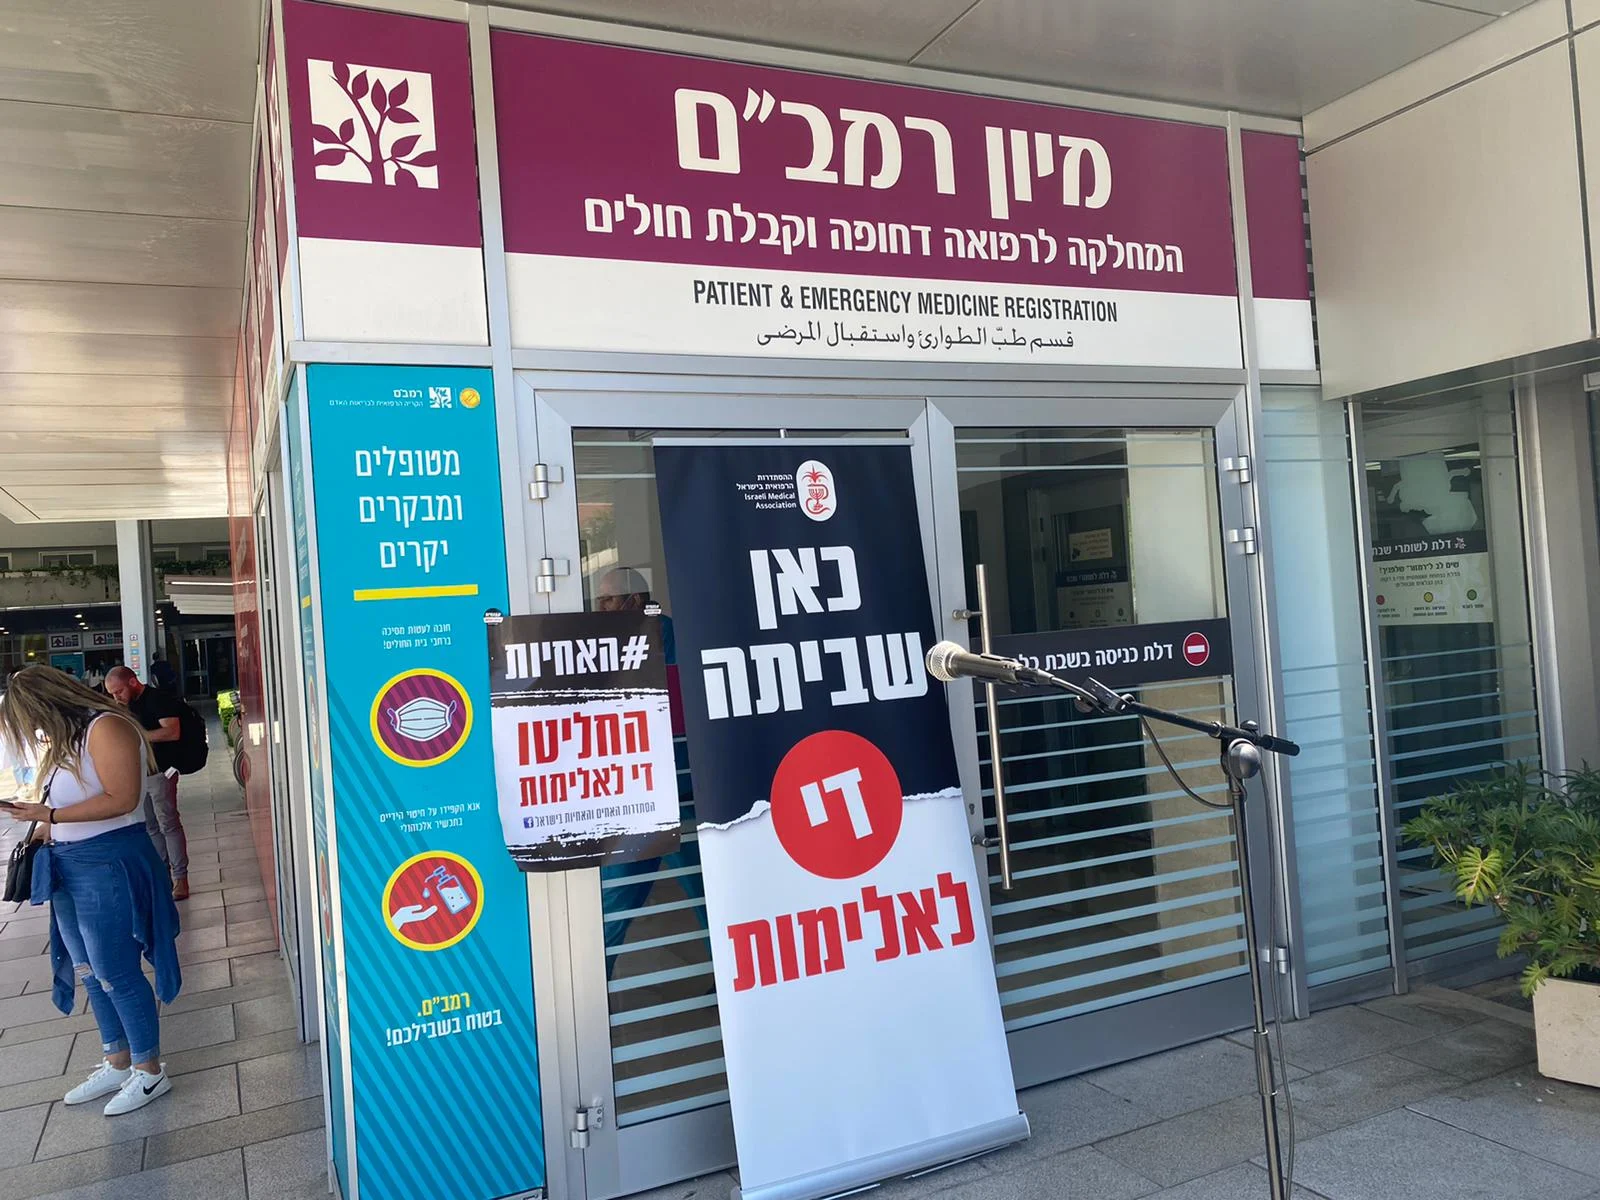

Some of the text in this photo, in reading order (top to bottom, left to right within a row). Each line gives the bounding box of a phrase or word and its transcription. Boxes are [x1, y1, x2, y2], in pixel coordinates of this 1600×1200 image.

[674, 87, 1113, 220] מיון רמב"ם
[584, 193, 1183, 274] המחלקה לרפואה דחופה וקבלת חולים
[693, 280, 1117, 322] PATIENT & EMERGENCY MEDICINE REGISTRATION
[757, 321, 821, 346] المرضى
[827, 321, 914, 348] واستقبال
[919, 326, 987, 349] الطوارئ
[1030, 330, 1074, 353] قسم
[355, 445, 460, 476] מטופלים
[736, 483, 764, 491] בישראל
[768, 492, 796, 500] Medical
[359, 495, 463, 528] ומבקרים
[755, 501, 797, 509] Association
[379, 540, 448, 573] יקרים
[1395, 540, 1428, 553] לשומרי
[1431, 539, 1451, 551] דלת
[749, 546, 861, 630] כאן
[408, 623, 431, 635] לעשות
[433, 624, 451, 633] חובה
[383, 637, 452, 650] ברחבי בית החולים!
[1143, 642, 1173, 662] דלת
[504, 635, 650, 680] #האחיות
[1045, 651, 1091, 672] בשבת
[1096, 647, 1138, 667] כניסה
[701, 631, 929, 720] שביתה
[517, 710, 650, 766] החליטו
[519, 762, 654, 807] די לאלימות
[428, 807, 437, 817] על
[440, 803, 465, 815] הקפידו
[467, 802, 480, 811] אנא
[535, 801, 656, 828] הסתדרות האחים והאחיות בישראל
[800, 767, 874, 839] די
[379, 812, 404, 823] הידיים
[435, 817, 463, 829] בתכשיר
[727, 871, 975, 993] לאלימות
[386, 1009, 502, 1047] בטוח בשבילכם!
